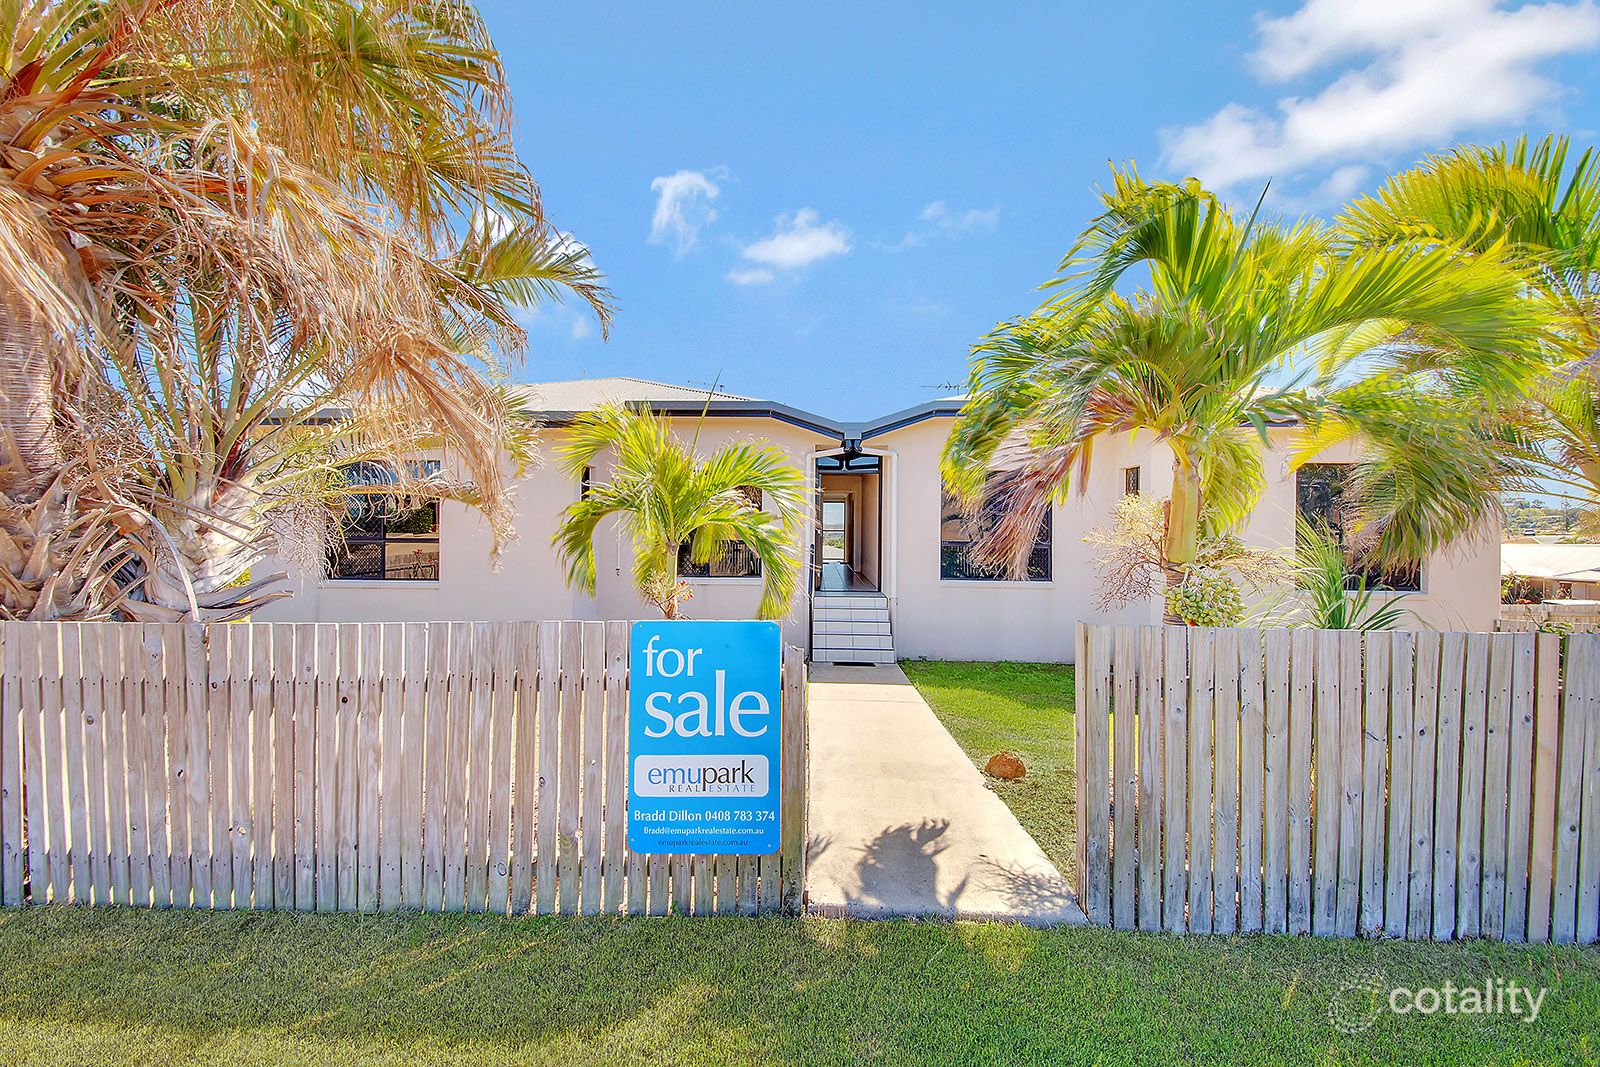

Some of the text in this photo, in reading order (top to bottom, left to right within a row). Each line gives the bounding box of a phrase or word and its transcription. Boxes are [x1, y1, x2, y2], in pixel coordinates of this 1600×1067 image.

[642, 634, 703, 678] for
[643, 669, 770, 738] sale
[647, 759, 755, 792] emupark
[668, 784, 756, 793] REAL ESTATE
[633, 810, 776, 822] Bradd Dillon 0408 783 374
[643, 826, 765, 836] Bradd@emuparkrealestate.com.au
[657, 839, 749, 848] emuparkrealestate.com.au
